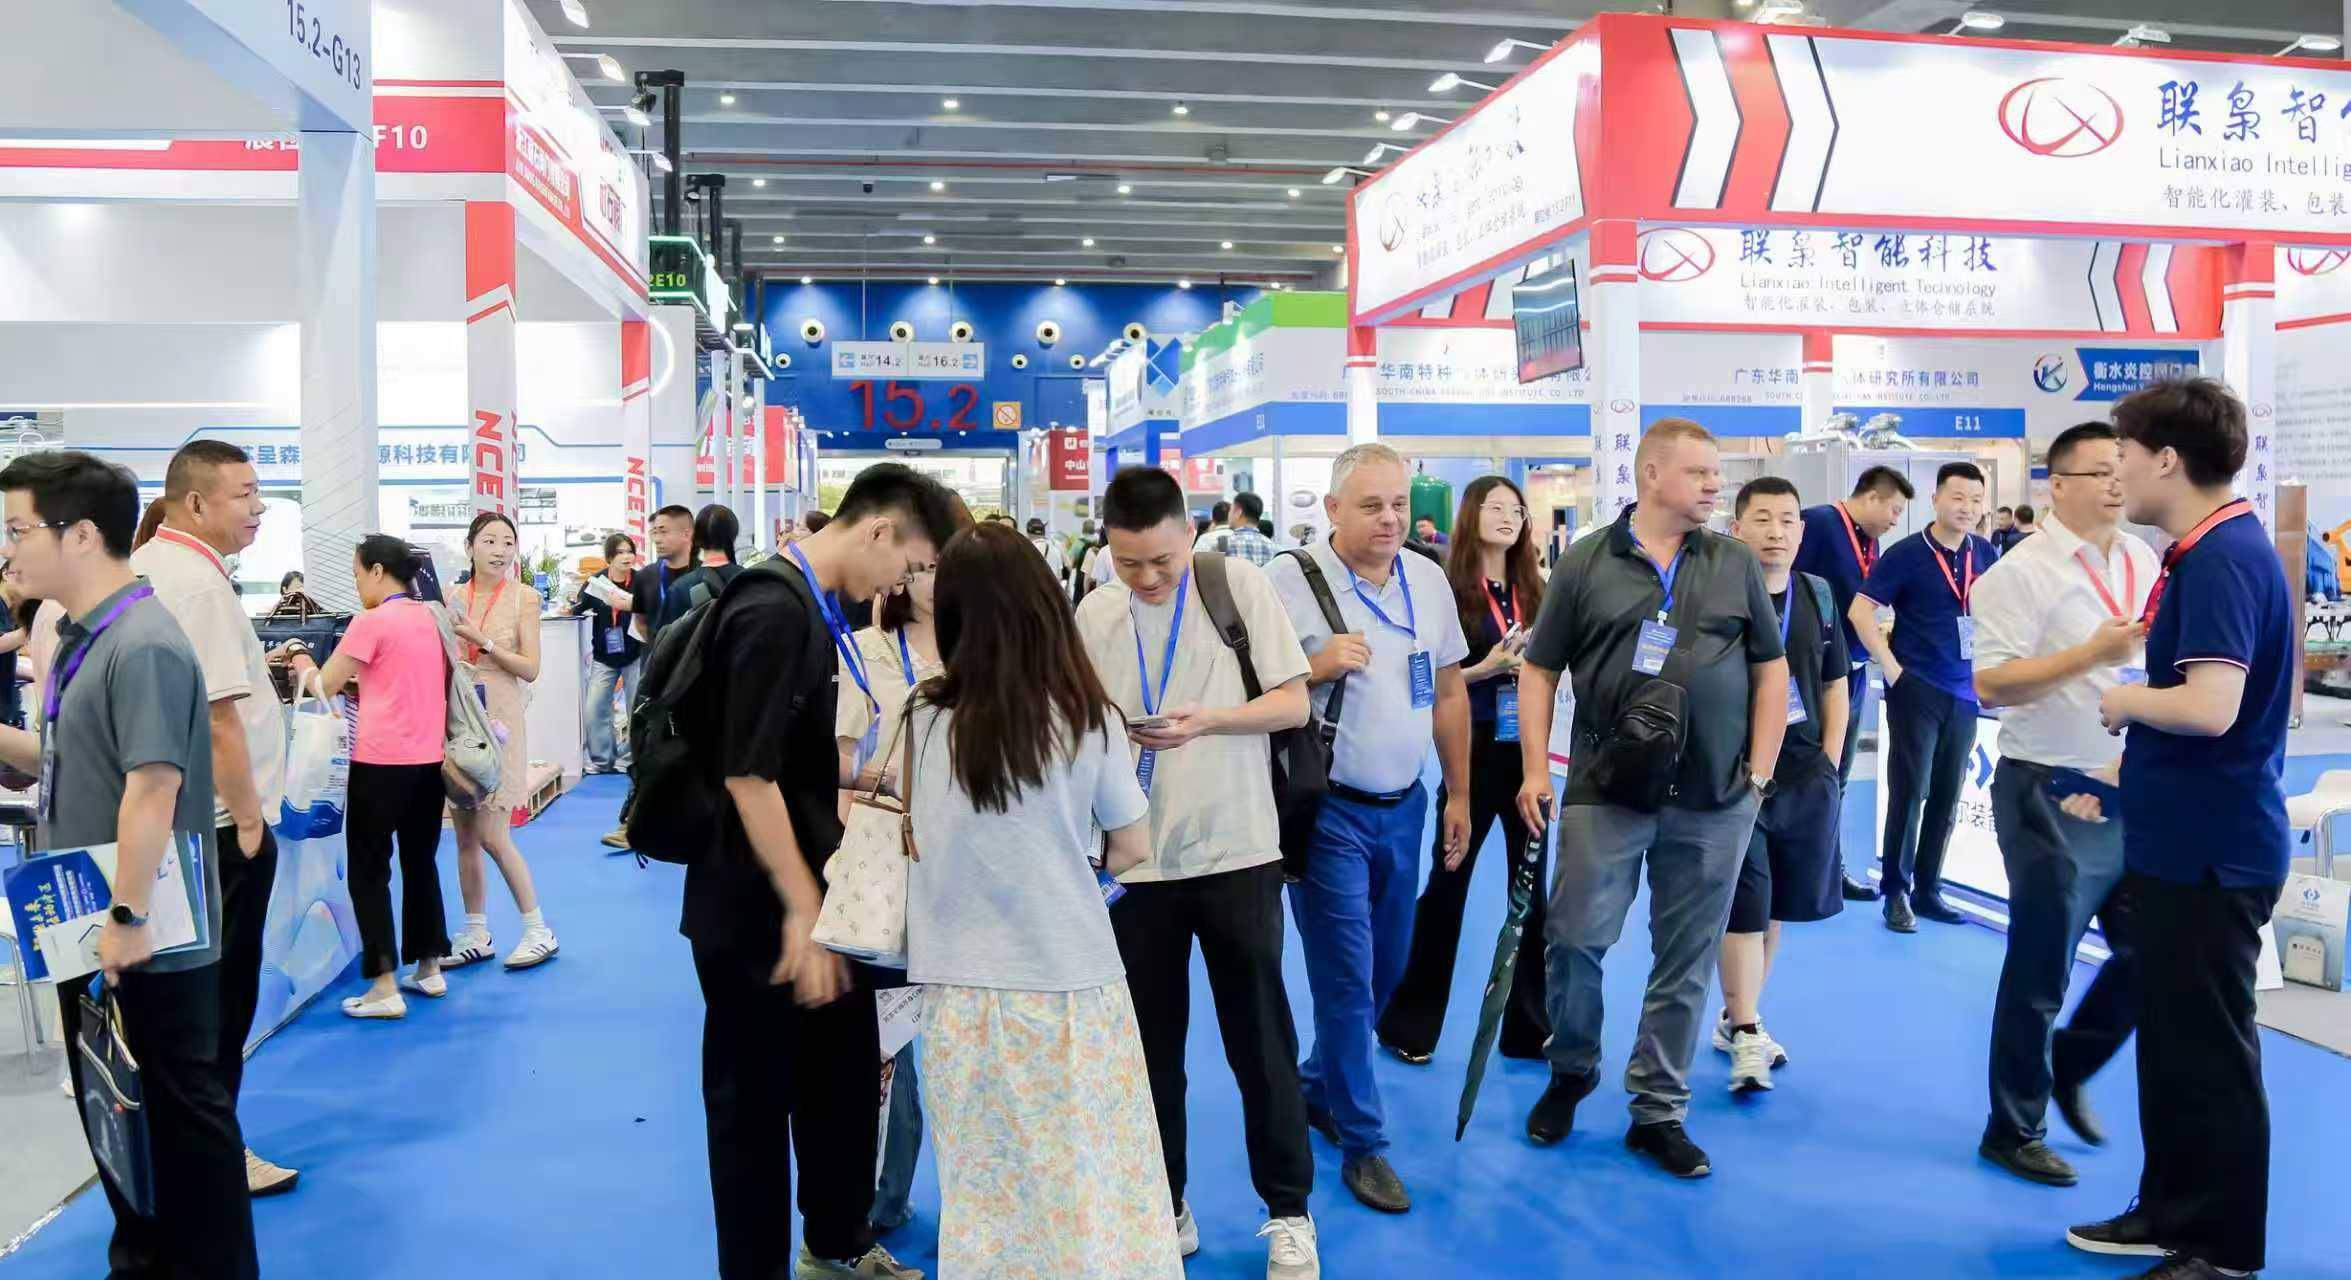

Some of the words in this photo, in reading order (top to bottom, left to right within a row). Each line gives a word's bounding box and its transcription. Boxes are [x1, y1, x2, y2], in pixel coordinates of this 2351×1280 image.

[287, 0, 361, 90] 15.2-G13
[2157, 80, 2351, 143] 联枭智
[2159, 147, 2254, 173] Lianxiao
[1739, 229, 1998, 272] 联枭智能科技
[1740, 276, 1809, 290] Lianxiao
[1820, 277, 1908, 296] Intelligent
[877, 355, 901, 367] 14.2
[1734, 368, 1799, 385] 广东华南
[2094, 382, 2136, 393] Hengshui
[848, 380, 980, 430] 15.2
[1954, 415, 1982, 431] E11
